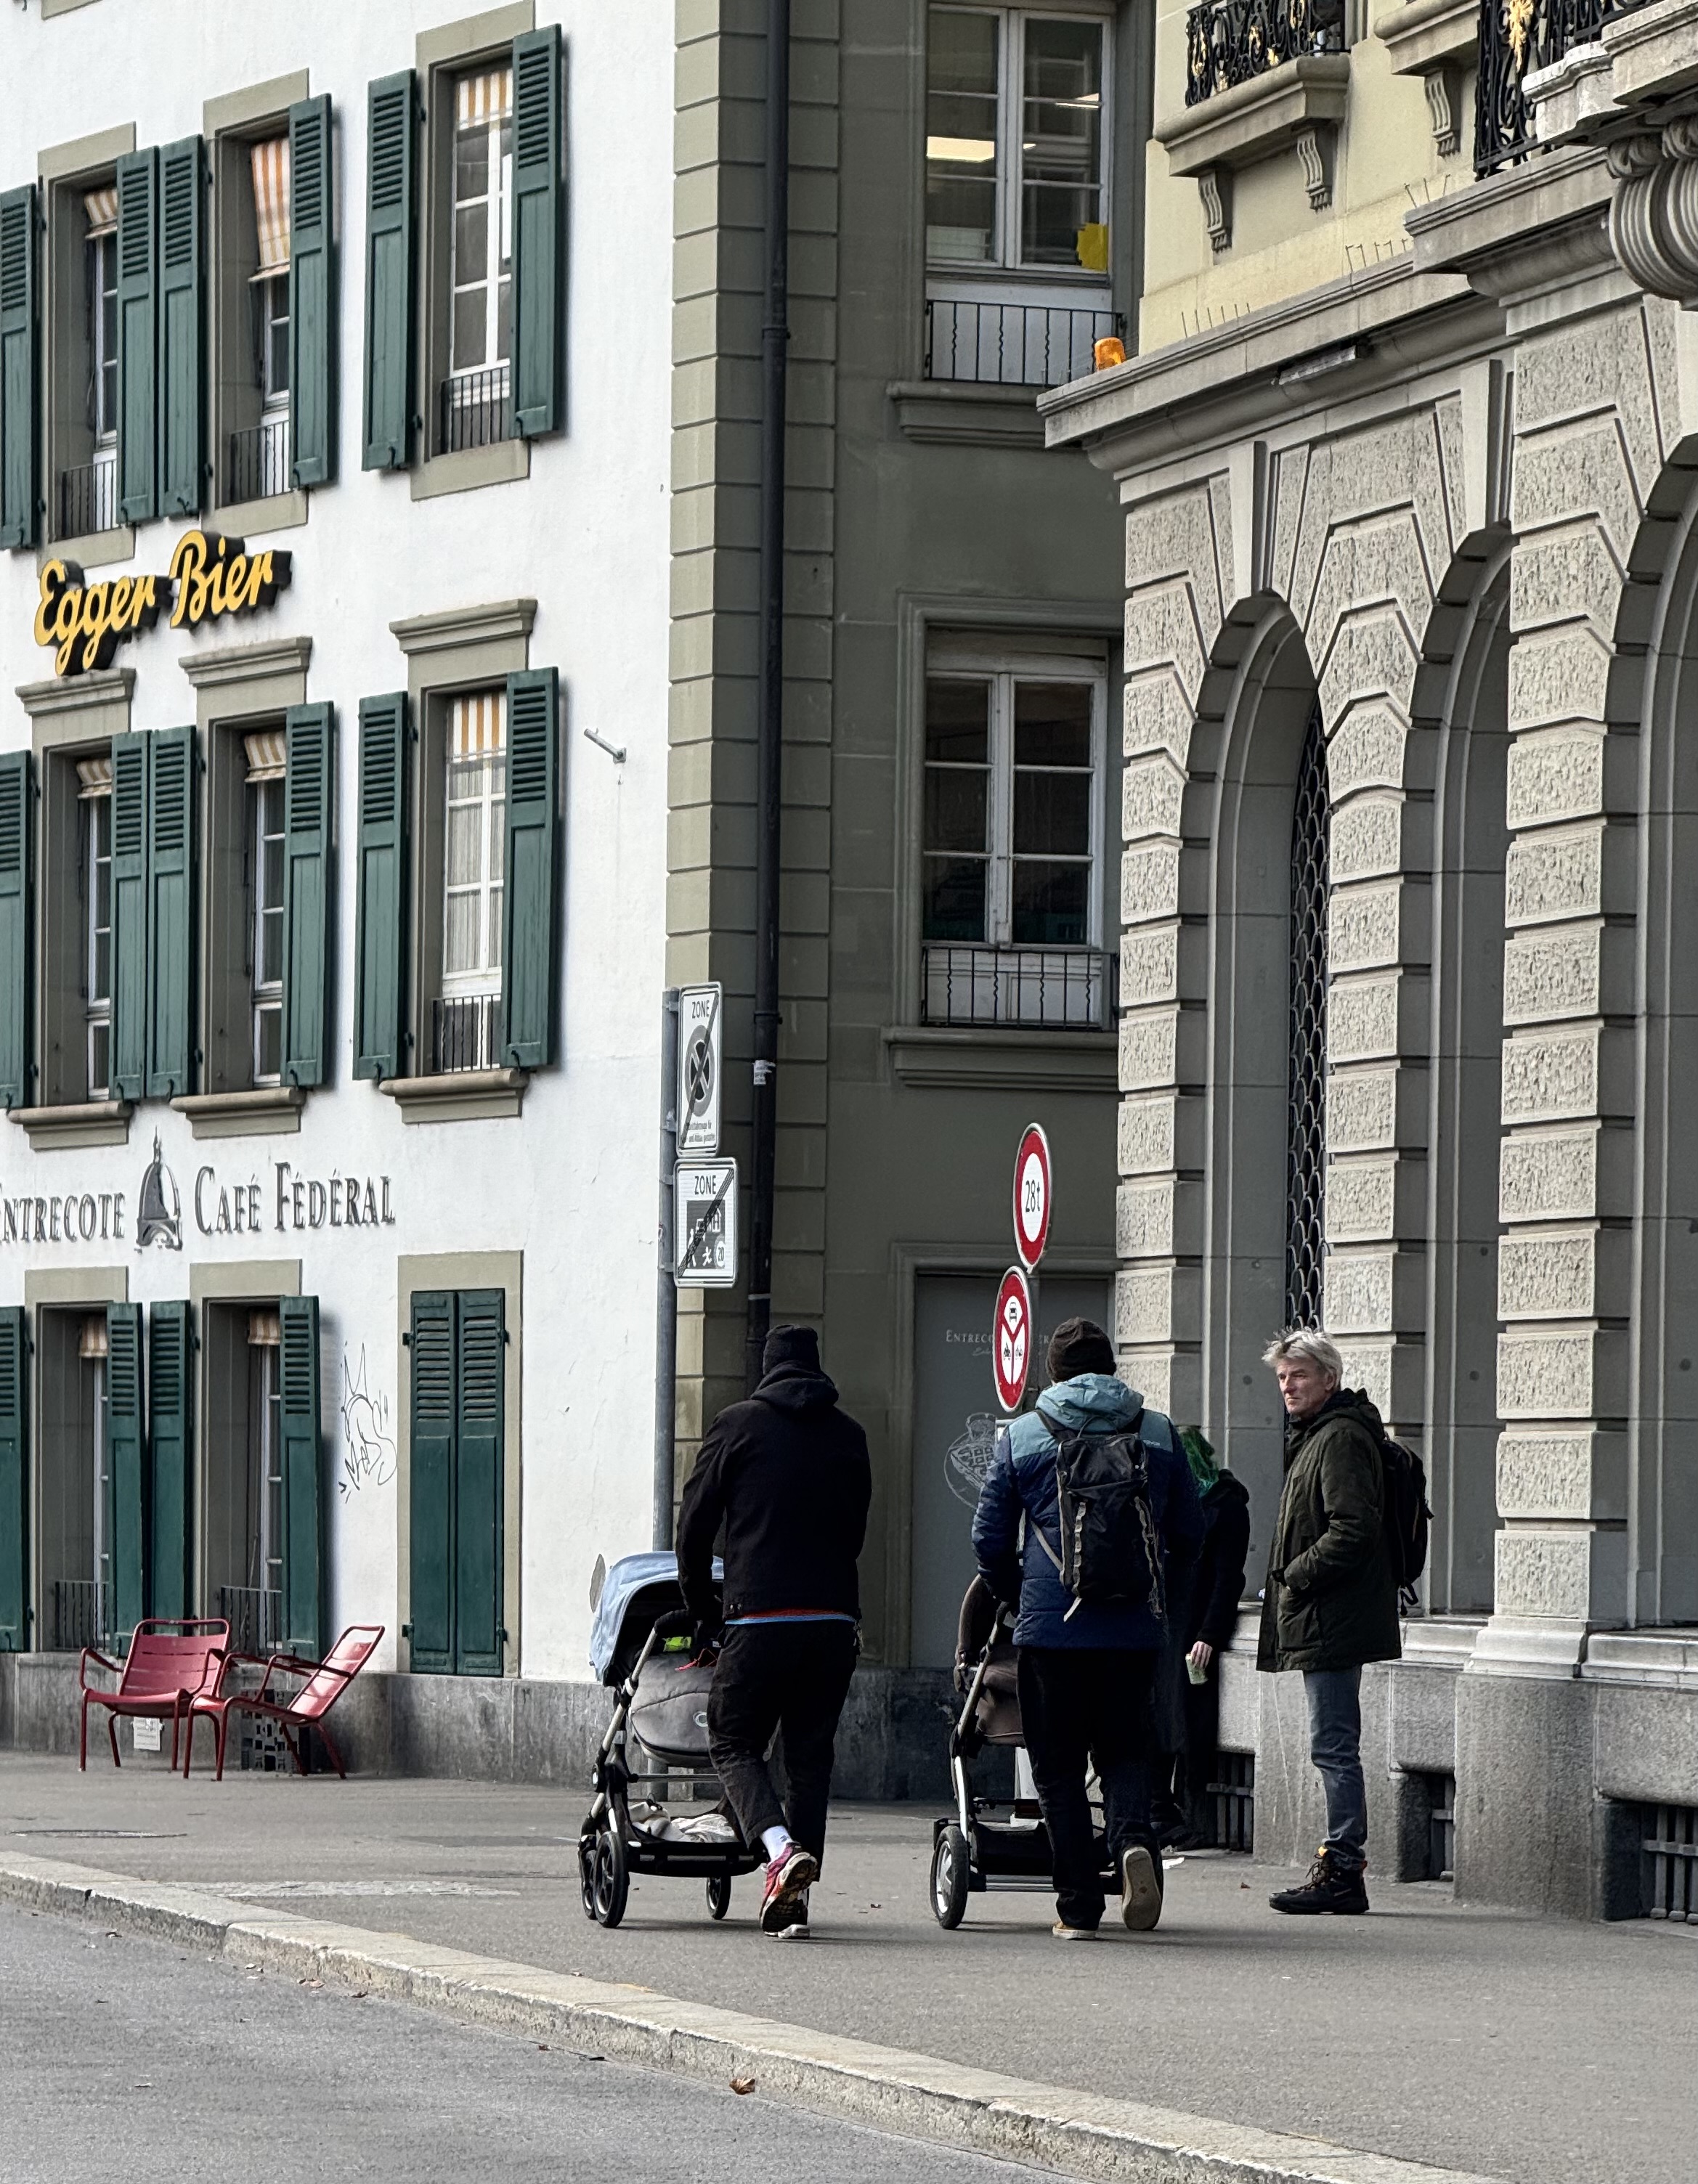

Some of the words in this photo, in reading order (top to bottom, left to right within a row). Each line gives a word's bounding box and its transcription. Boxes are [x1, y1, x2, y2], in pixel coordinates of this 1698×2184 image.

[34, 558, 156, 677] Egger
[170, 529, 274, 629] Bier
[691, 1000, 710, 1019] ZONE
[694, 1174, 717, 1196] ZONE
[1025, 1179, 1041, 1213] 28t
[0, 1191, 126, 1244] NTRECOTE
[195, 1166, 262, 1235] CAFÉ
[275, 1162, 396, 1234] FÉDÉRAL
